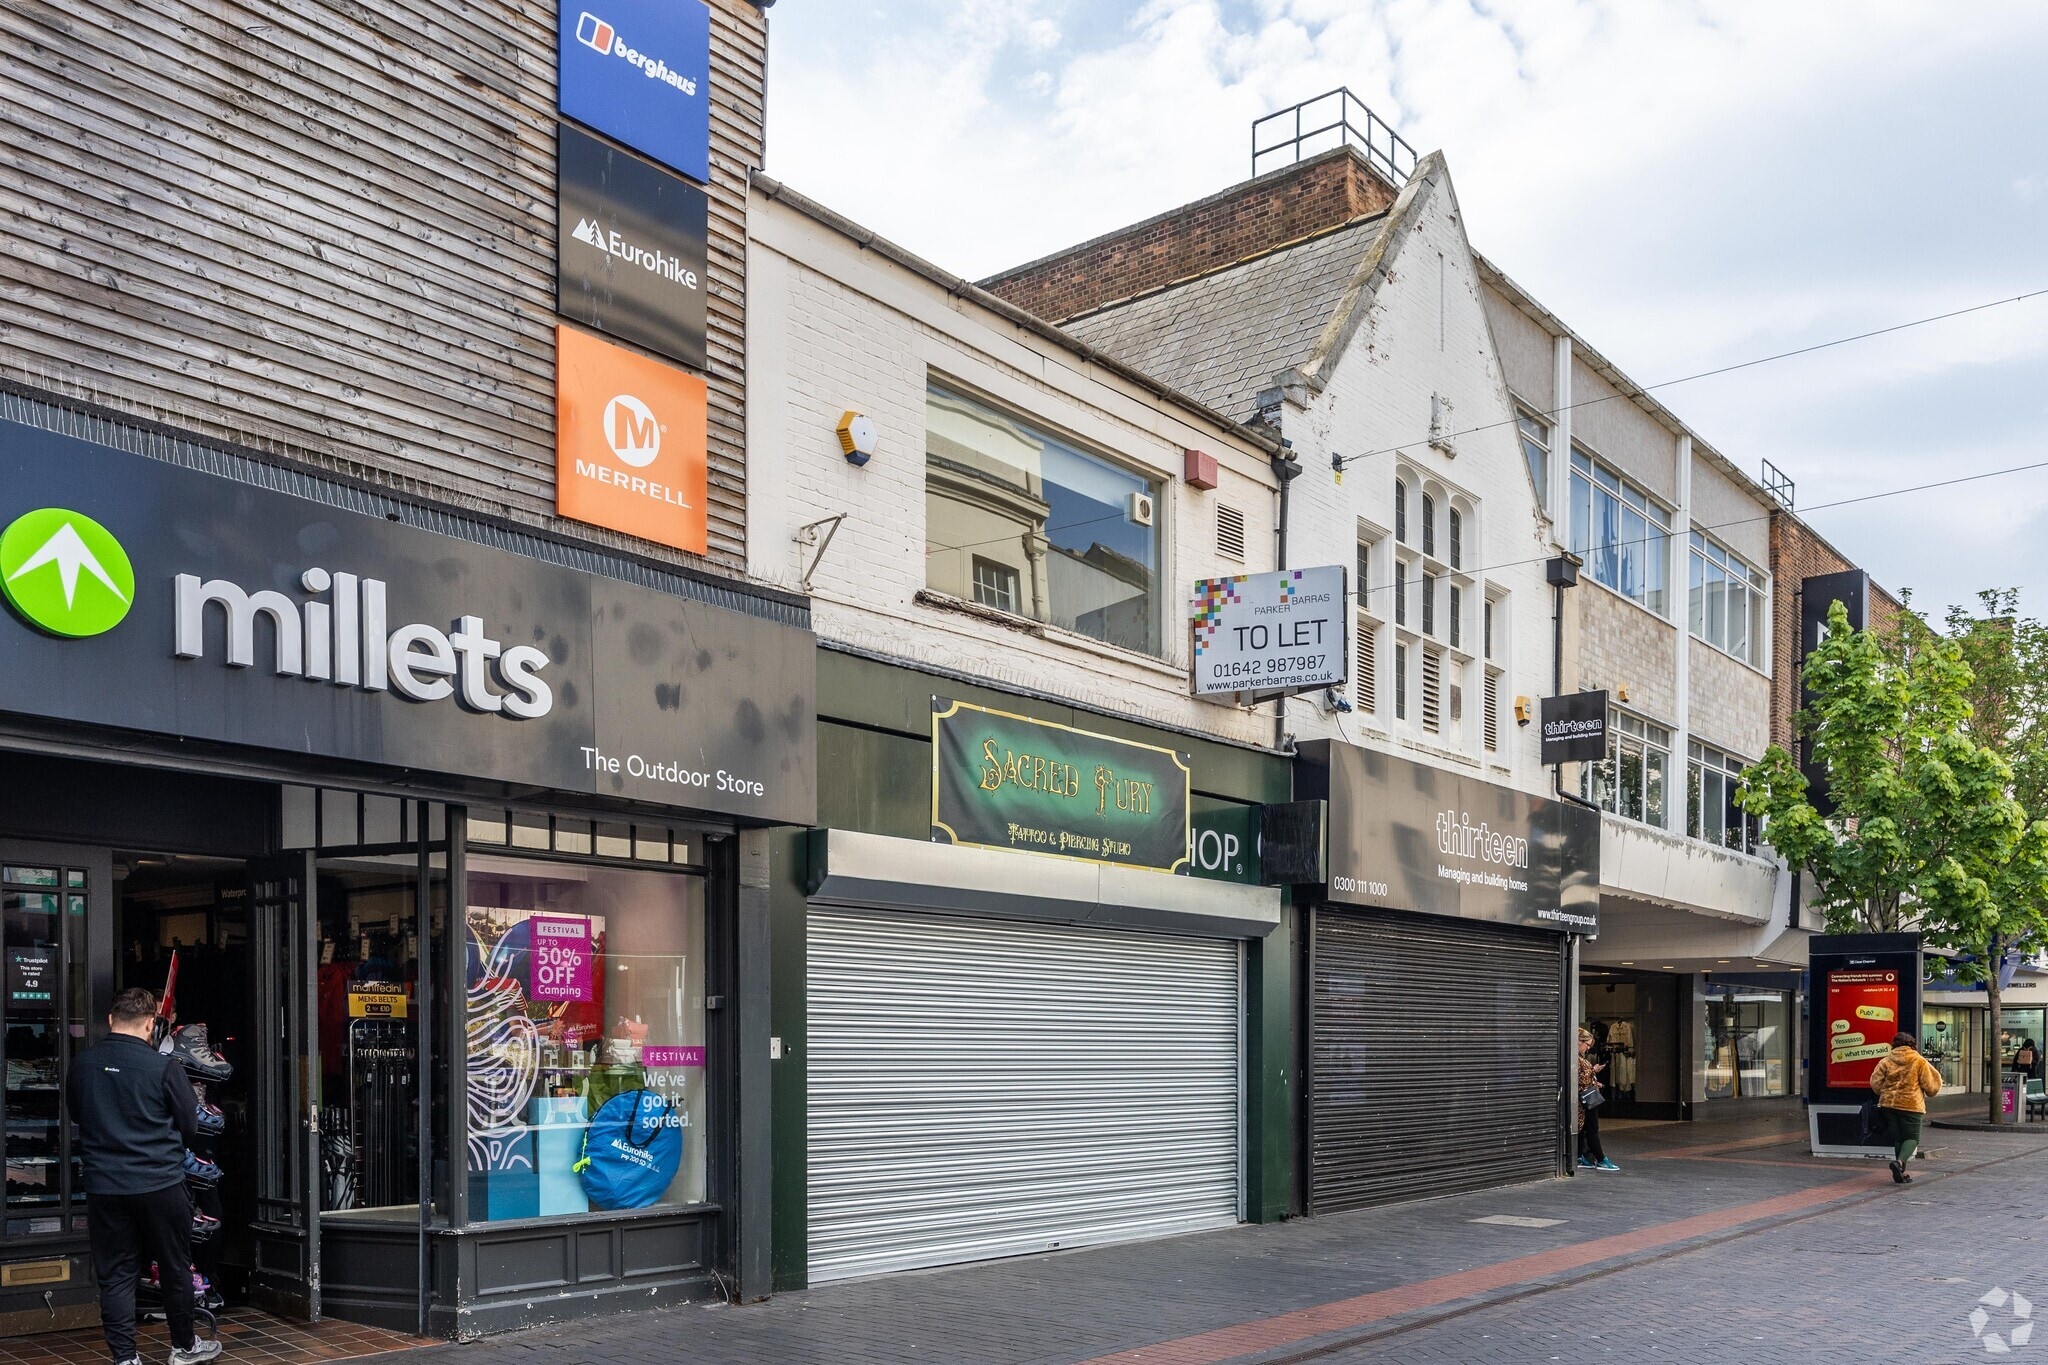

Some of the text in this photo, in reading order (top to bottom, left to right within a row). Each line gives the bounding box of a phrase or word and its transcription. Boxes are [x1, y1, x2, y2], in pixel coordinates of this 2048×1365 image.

[614, 36, 696, 96] berghaus
[609, 230, 698, 290] Eurohike
[575, 459, 692, 509] MERRELL
[1291, 593, 1330, 606] BARRAS
[1254, 604, 1291, 616] PARKER
[174, 567, 553, 719] millets
[1233, 619, 1328, 652] TO LET
[1213, 654, 1326, 678] 01642 987987
[1206, 670, 1333, 691] www.parkerbarras.co.uk
[1545, 719, 1602, 735] thirteen
[580, 746, 764, 797] The Outdoor Store
[1436, 810, 1529, 869] thirteen
[1334, 876, 1388, 897] 0300 111 1000
[1438, 864, 1528, 892] Managing and building homes
[1537, 908, 1597, 927] www.thirteengroup.co.uk
[542, 926, 580, 935] FESTIVAL
[537, 938, 547, 946] UP
[538, 946, 582, 967] 50%
[25, 980, 38, 988] 4.9
[538, 965, 576, 985] OFF
[357, 995, 377, 1003] MENS
[538, 985, 581, 998] Camping
[1860, 1008, 1874, 1017] Pub?
[649, 1052, 698, 1061] FESTIVAL
[1844, 1050, 1860, 1058] what
[1861, 1048, 1875, 1058] they
[642, 1070, 686, 1088] We've
[642, 1090, 681, 1113] got it
[642, 1111, 693, 1129] sorted.
[622, 1142, 654, 1162] Eurohike
